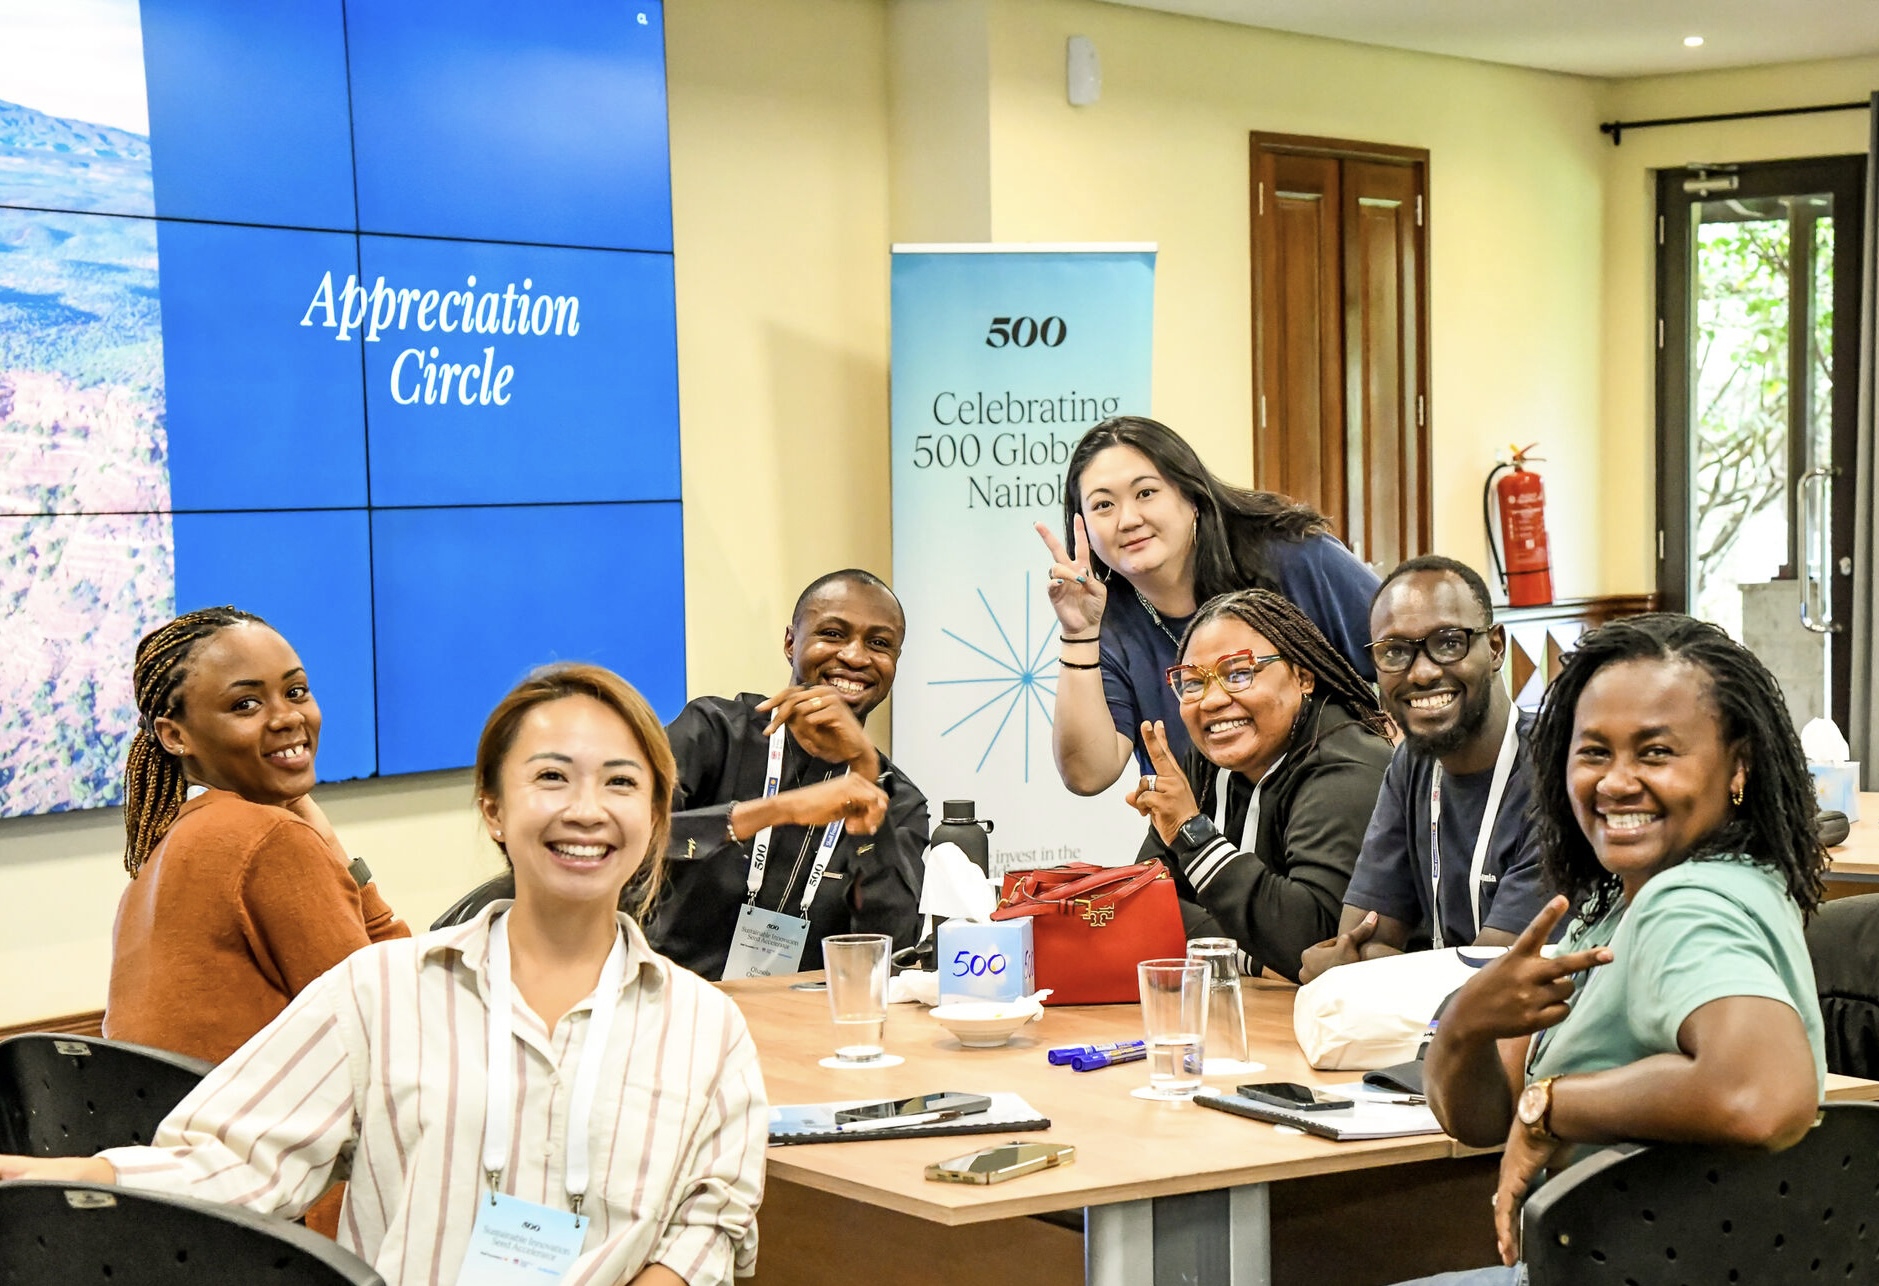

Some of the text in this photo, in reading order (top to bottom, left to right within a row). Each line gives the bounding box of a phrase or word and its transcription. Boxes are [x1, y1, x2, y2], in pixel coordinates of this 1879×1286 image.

[300, 270, 580, 342] Appreciation
[986, 316, 1067, 348] 500
[390, 346, 515, 406] Circle
[933, 390, 1120, 426] Celebrating
[913, 433, 981, 469] 500
[754, 843, 767, 871] 500
[995, 844, 1081, 864] invest in the
[808, 863, 824, 887] 500
[952, 950, 1006, 977] 500
